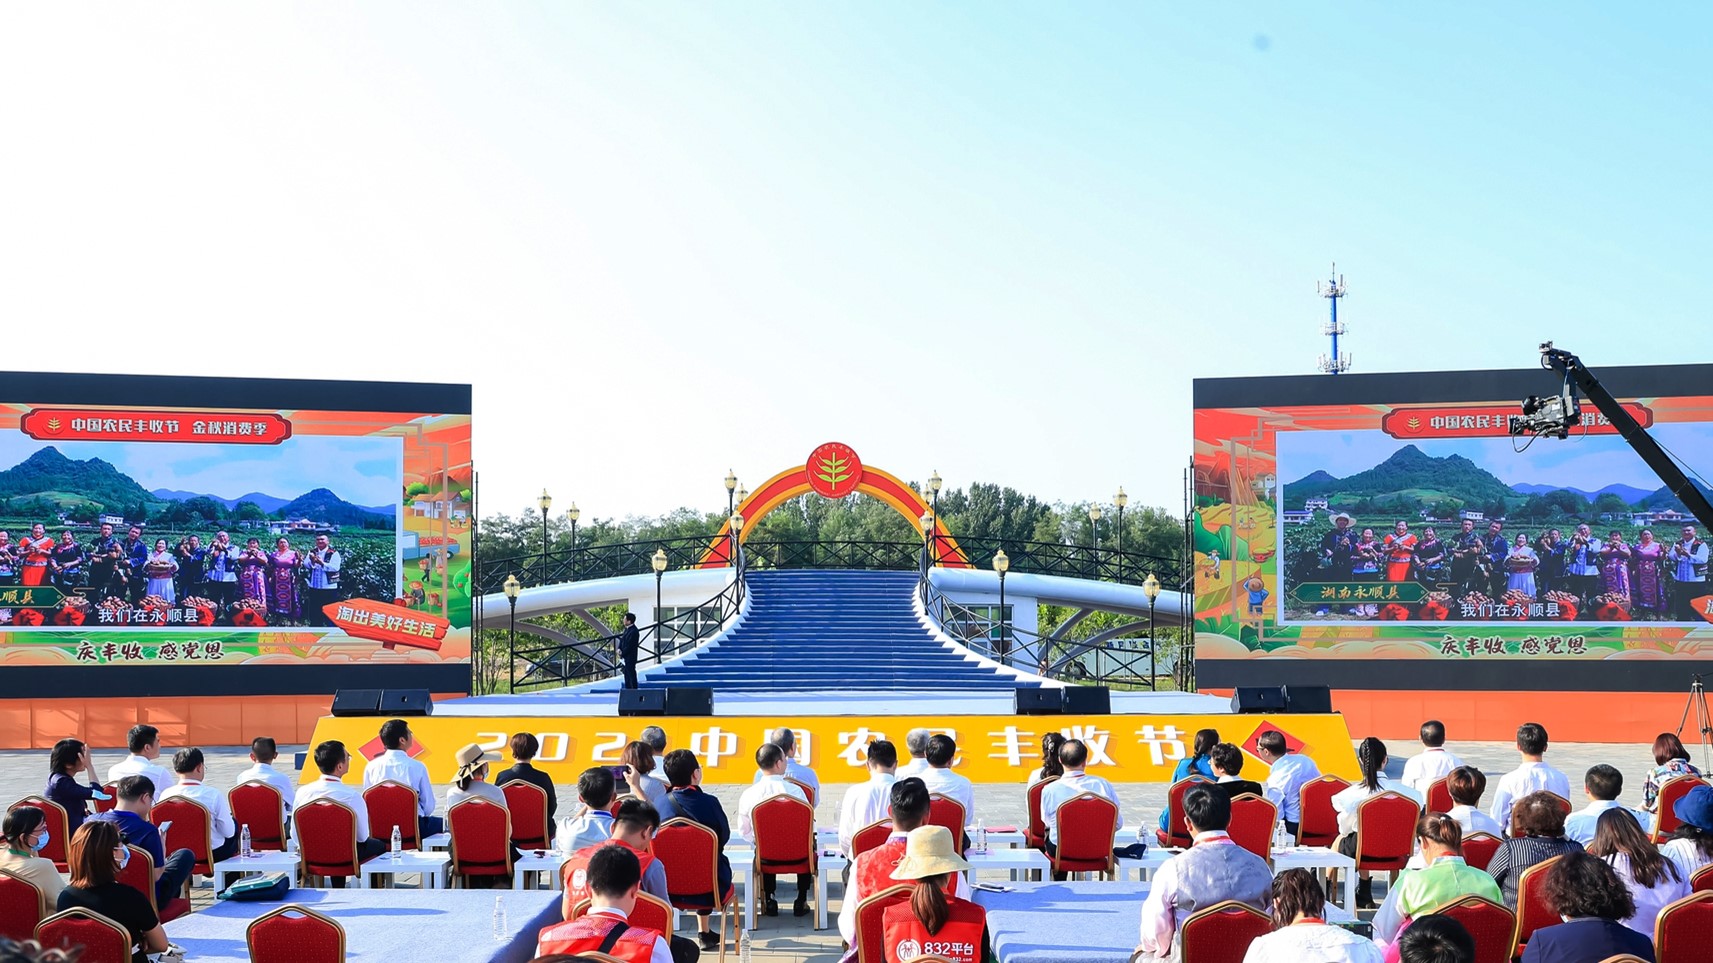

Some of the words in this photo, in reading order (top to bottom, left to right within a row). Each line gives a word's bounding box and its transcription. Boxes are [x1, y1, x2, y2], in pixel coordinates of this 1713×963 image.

[71, 417, 179, 433] 中国农民丰收节
[192, 421, 267, 436] 金秋消费季
[1320, 585, 1400, 600] 湖南永顺县
[98, 608, 198, 623] 我们在永顺县
[1460, 603, 1560, 618] 我们在永顺县
[336, 606, 436, 638] 淘出美好生活
[76, 641, 143, 661] 庆丰收
[158, 641, 224, 661] 感党恩
[1440, 636, 1507, 656] 庆丰收
[1521, 636, 1587, 655] 感党恩
[924, 942, 974, 955] 832平台
